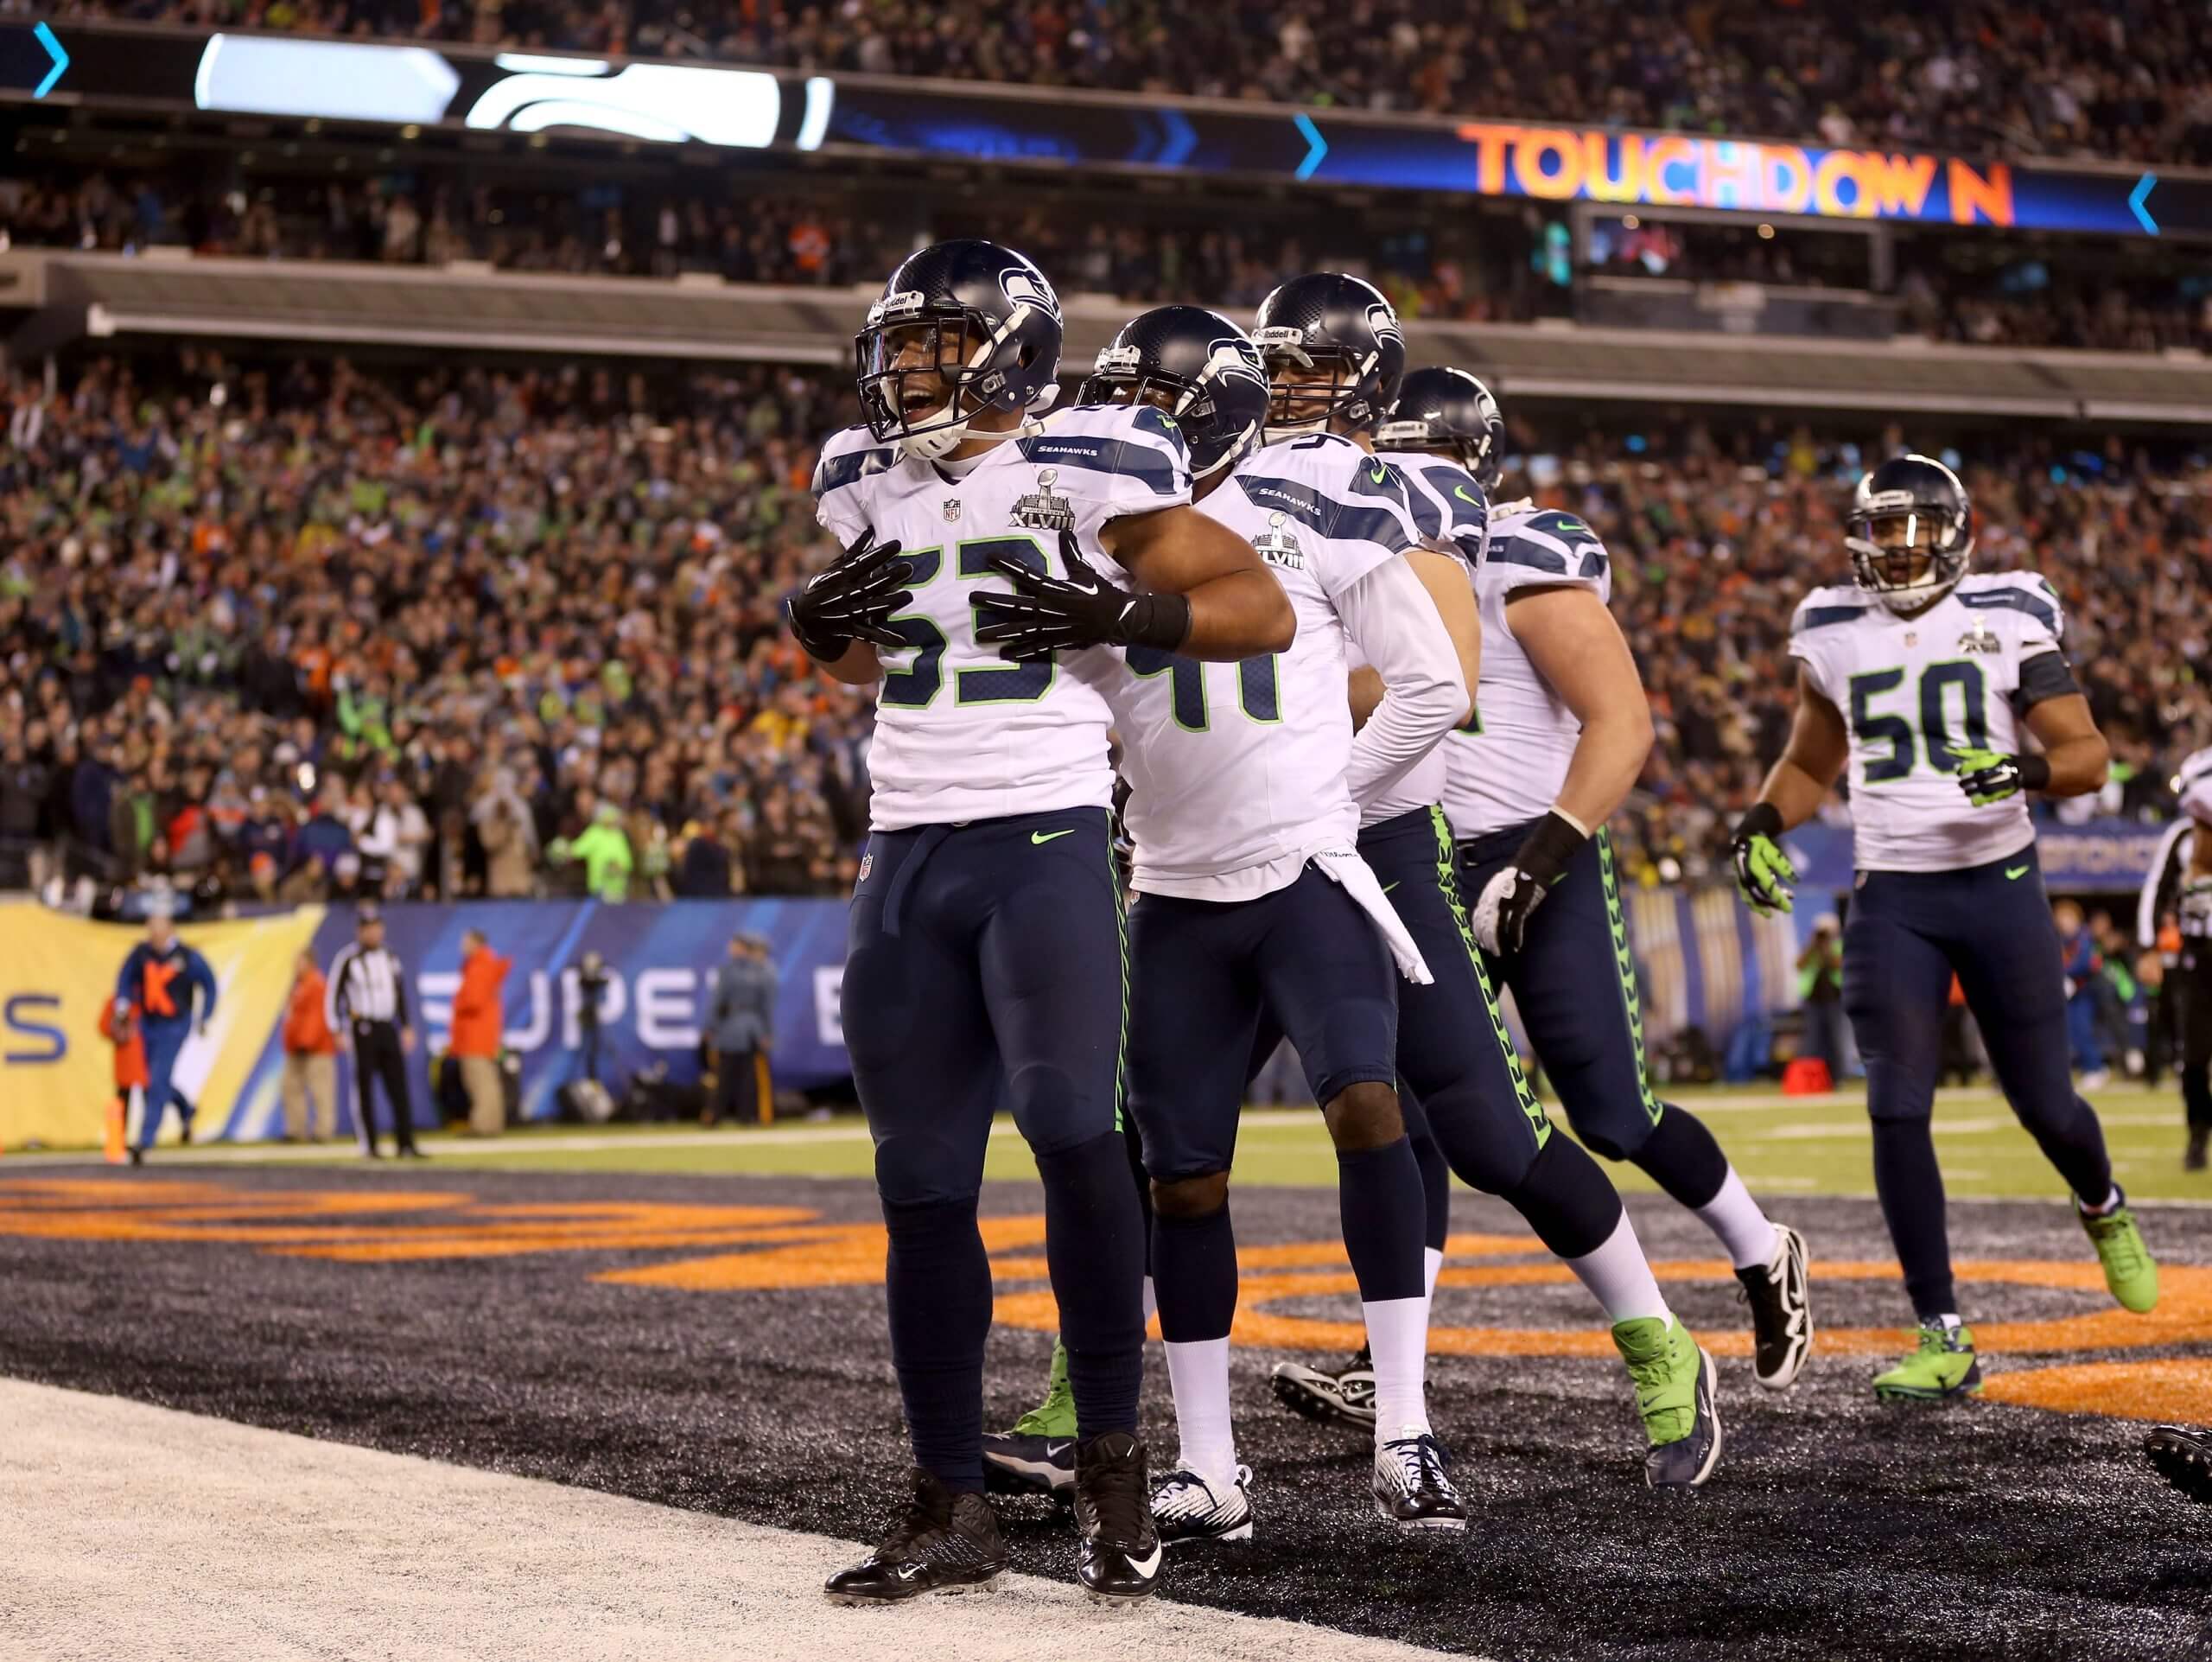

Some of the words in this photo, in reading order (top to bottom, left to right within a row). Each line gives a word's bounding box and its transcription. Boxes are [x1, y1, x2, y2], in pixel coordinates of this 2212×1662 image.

[1459, 123, 2014, 226] TOUCHDOWN
[1037, 445, 1098, 456] SEAHAWKS
[1258, 487, 1322, 516] SEAHAWKS
[1258, 550, 1304, 570] LVIII
[1848, 659, 1991, 786] 50
[418, 966, 721, 1056] SUPE
